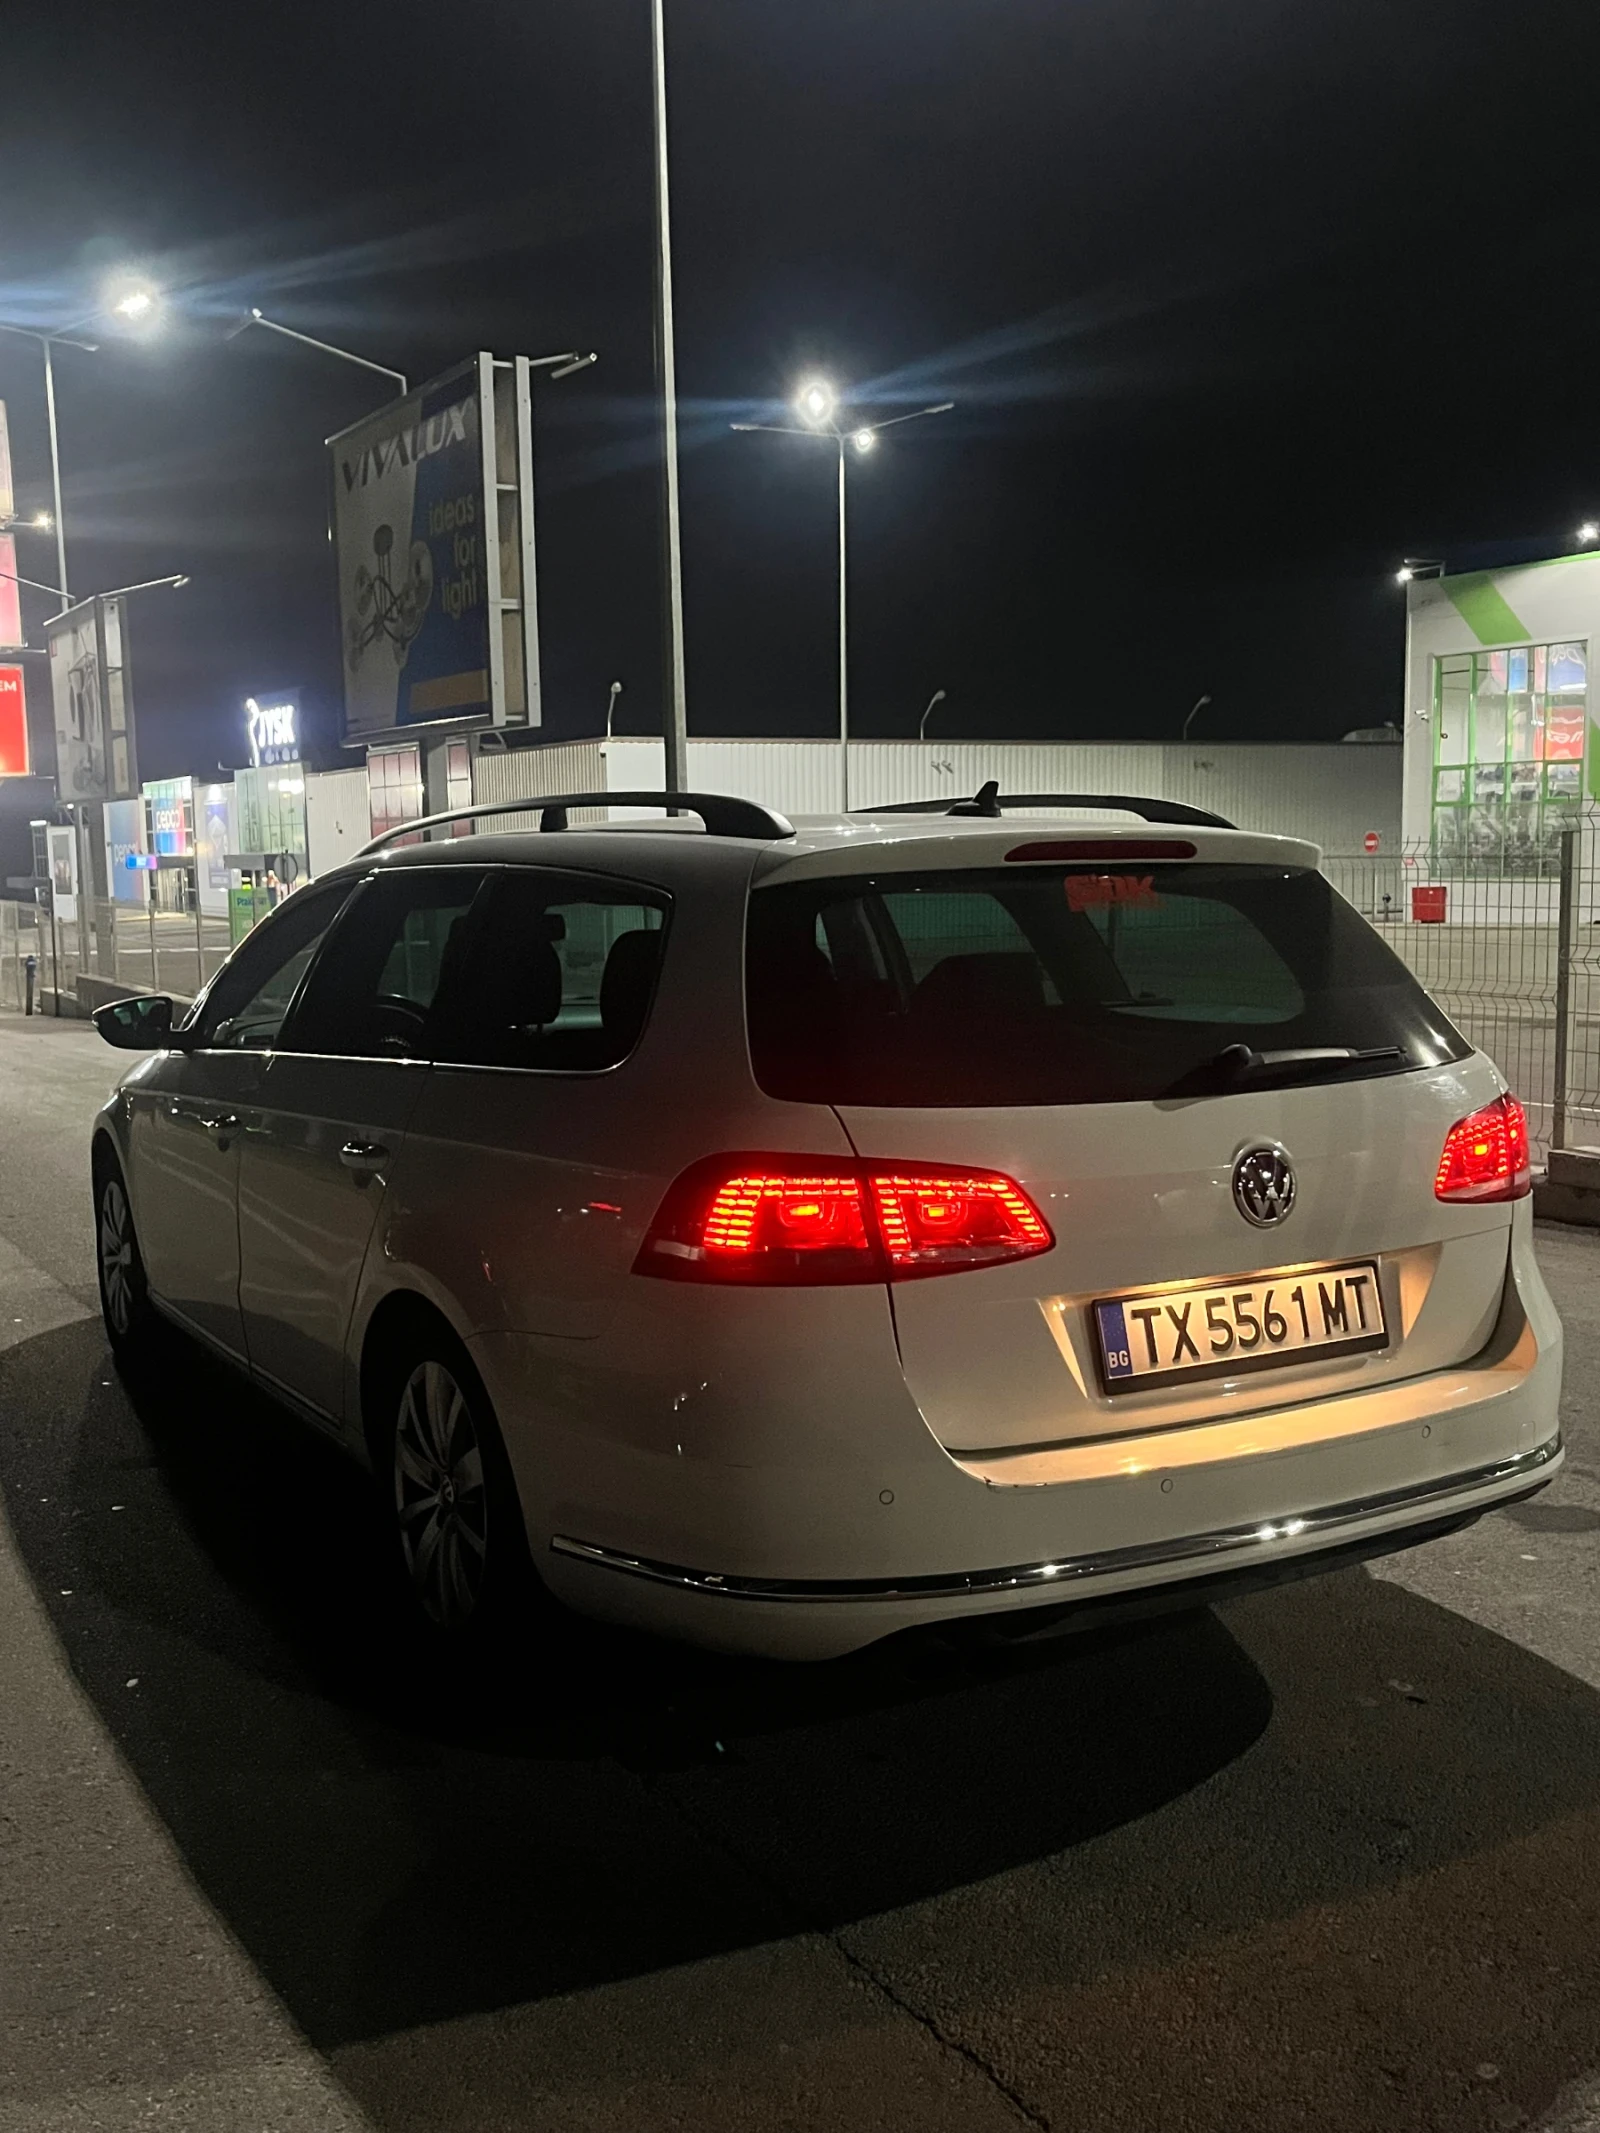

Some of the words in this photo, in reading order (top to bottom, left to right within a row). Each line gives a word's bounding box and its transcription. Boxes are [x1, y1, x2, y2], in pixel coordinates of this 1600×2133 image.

[342, 396, 475, 493] VIVALUX
[429, 493, 476, 536] ideas
[454, 531, 476, 568] for
[442, 567, 477, 620] light
[258, 705, 296, 748] JYSK
[156, 808, 180, 832] pepco
[1131, 1301, 1201, 1366] TX
[1204, 1286, 1310, 1352] 5561
[1318, 1274, 1368, 1336] MT
[1108, 1350, 1129, 1369] BG
